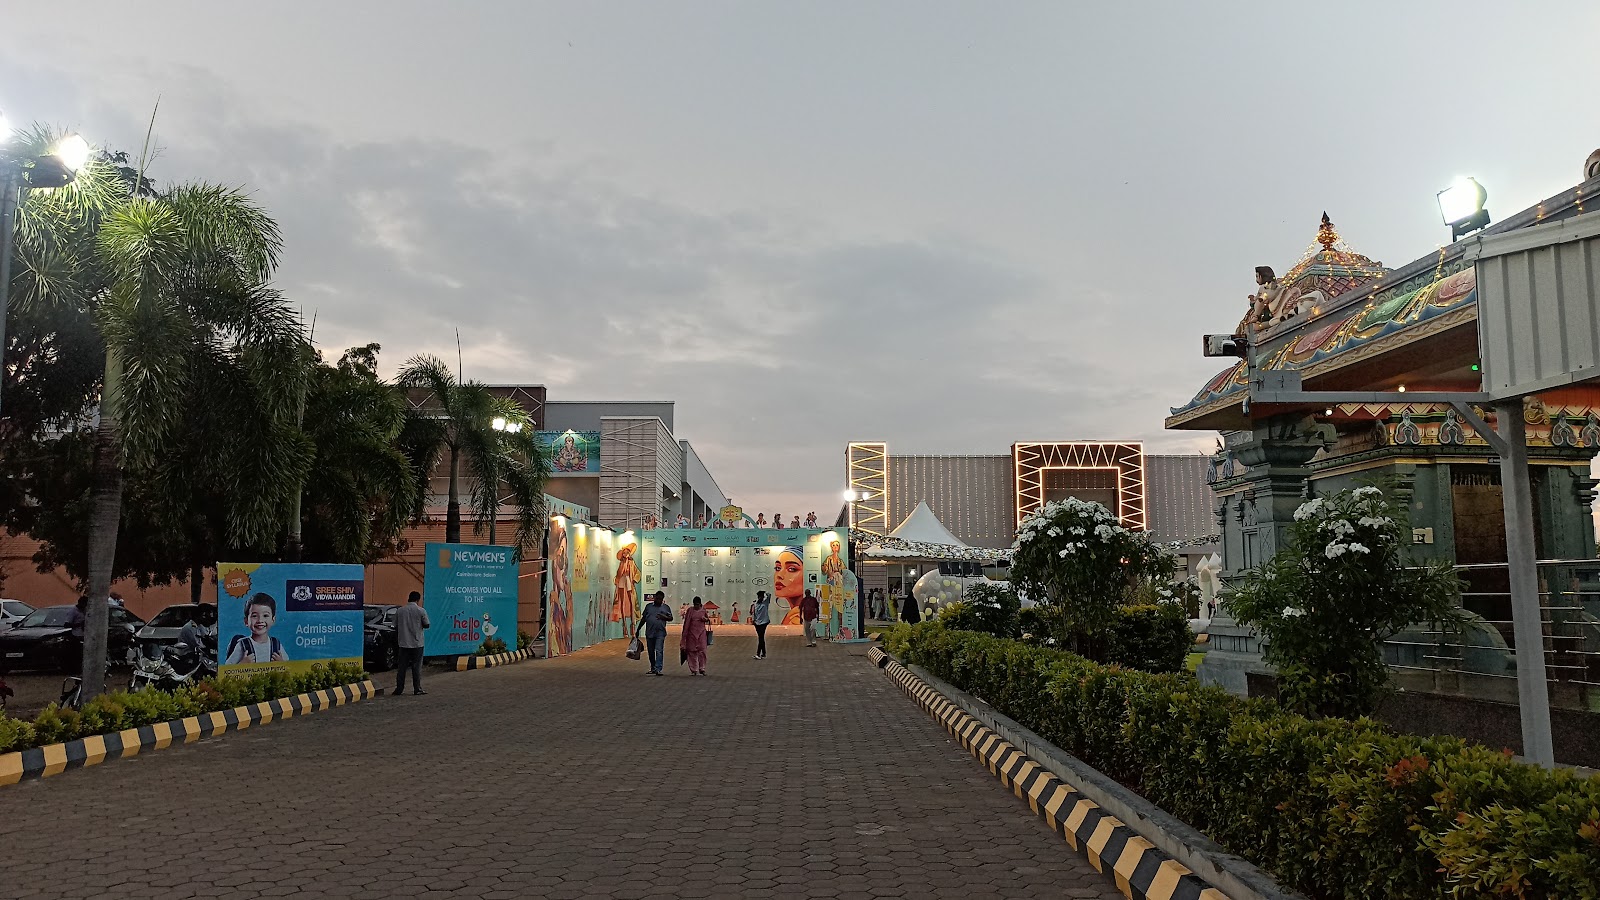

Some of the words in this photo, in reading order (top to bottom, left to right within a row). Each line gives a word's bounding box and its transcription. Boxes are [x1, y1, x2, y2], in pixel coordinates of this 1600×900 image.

[454, 551, 506, 563] NEWMEN'S
[315, 586, 336, 594] SREE
[336, 586, 355, 594] SHIV
[445, 586, 478, 594] WELCOMES
[480, 586, 492, 594] YOU
[492, 586, 502, 594] ALL
[453, 615, 480, 629] hello
[295, 623, 354, 634] Admissions
[295, 635, 326, 648] Open!
[449, 629, 480, 642] mello
